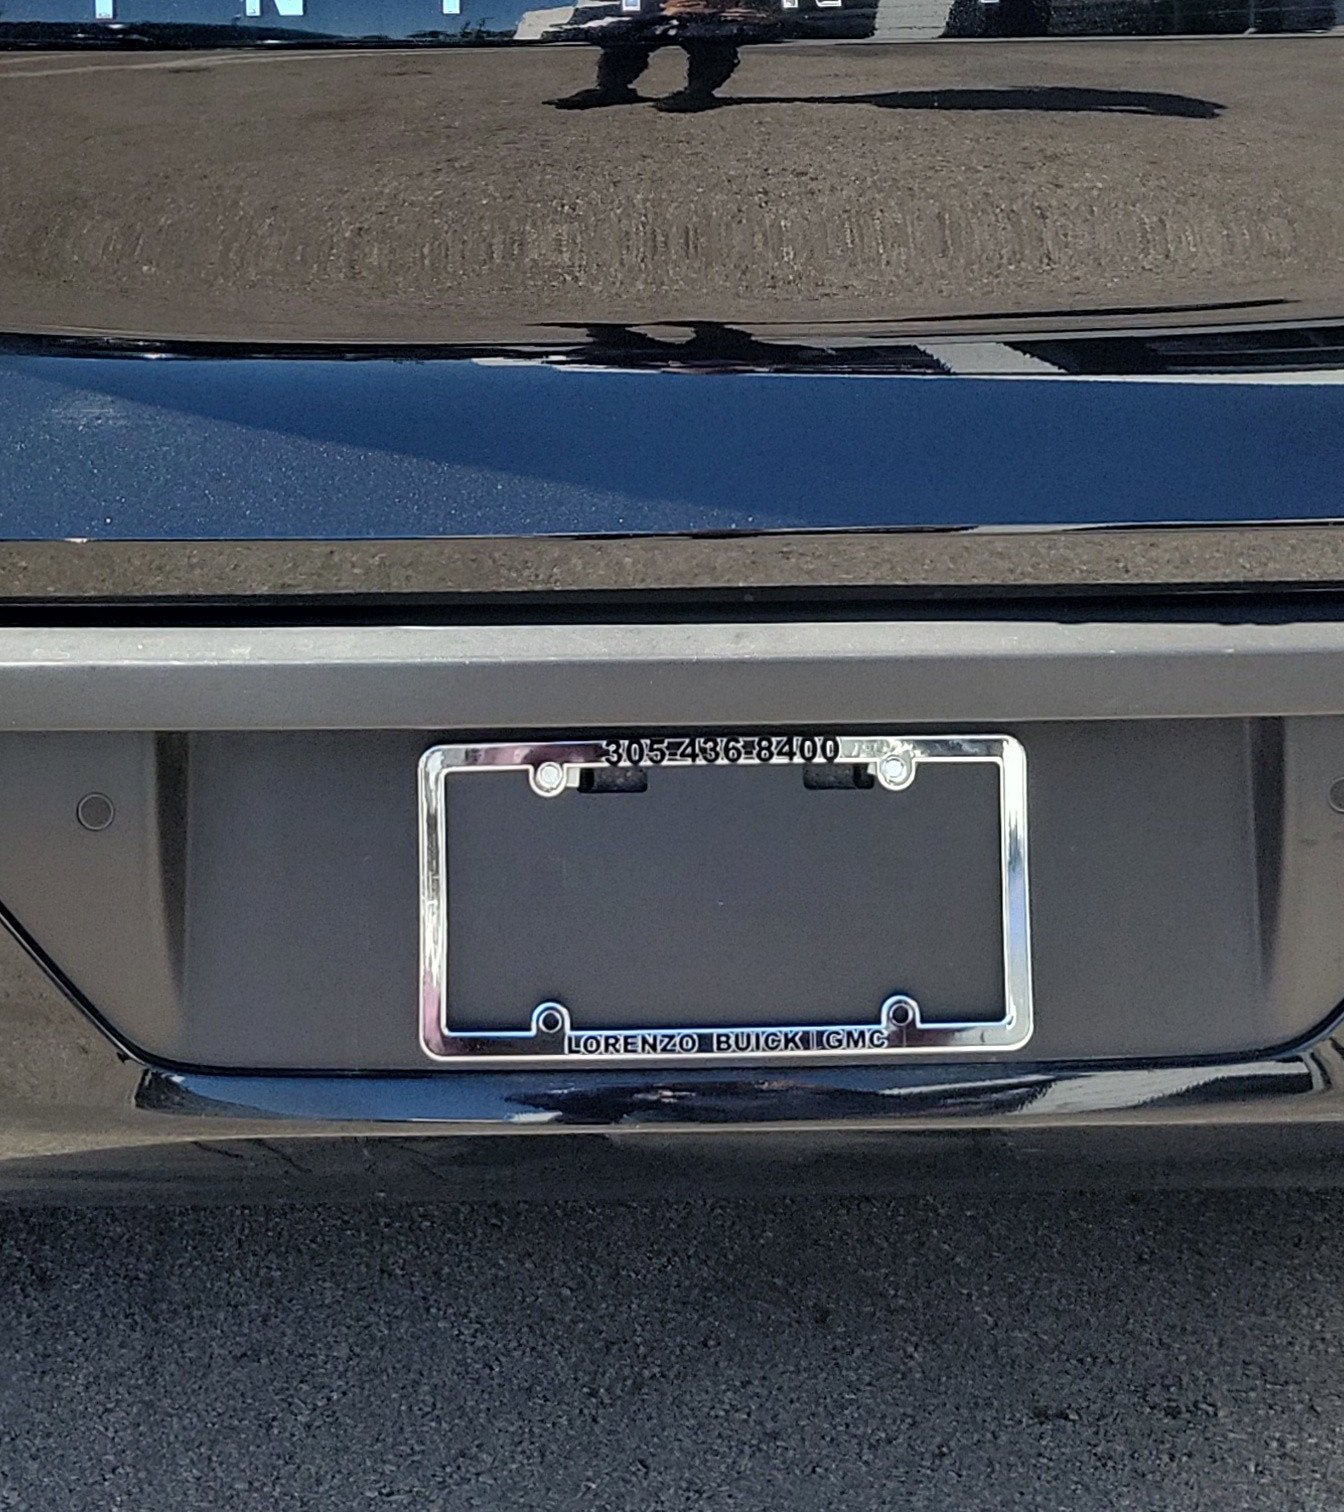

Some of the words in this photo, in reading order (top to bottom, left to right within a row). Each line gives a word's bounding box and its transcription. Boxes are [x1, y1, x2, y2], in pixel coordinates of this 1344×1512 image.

[603, 736, 841, 766] 305-436-8400
[565, 1033, 699, 1055] LORENZO
[712, 1031, 804, 1053] BUICK
[822, 1029, 888, 1051] GMC
